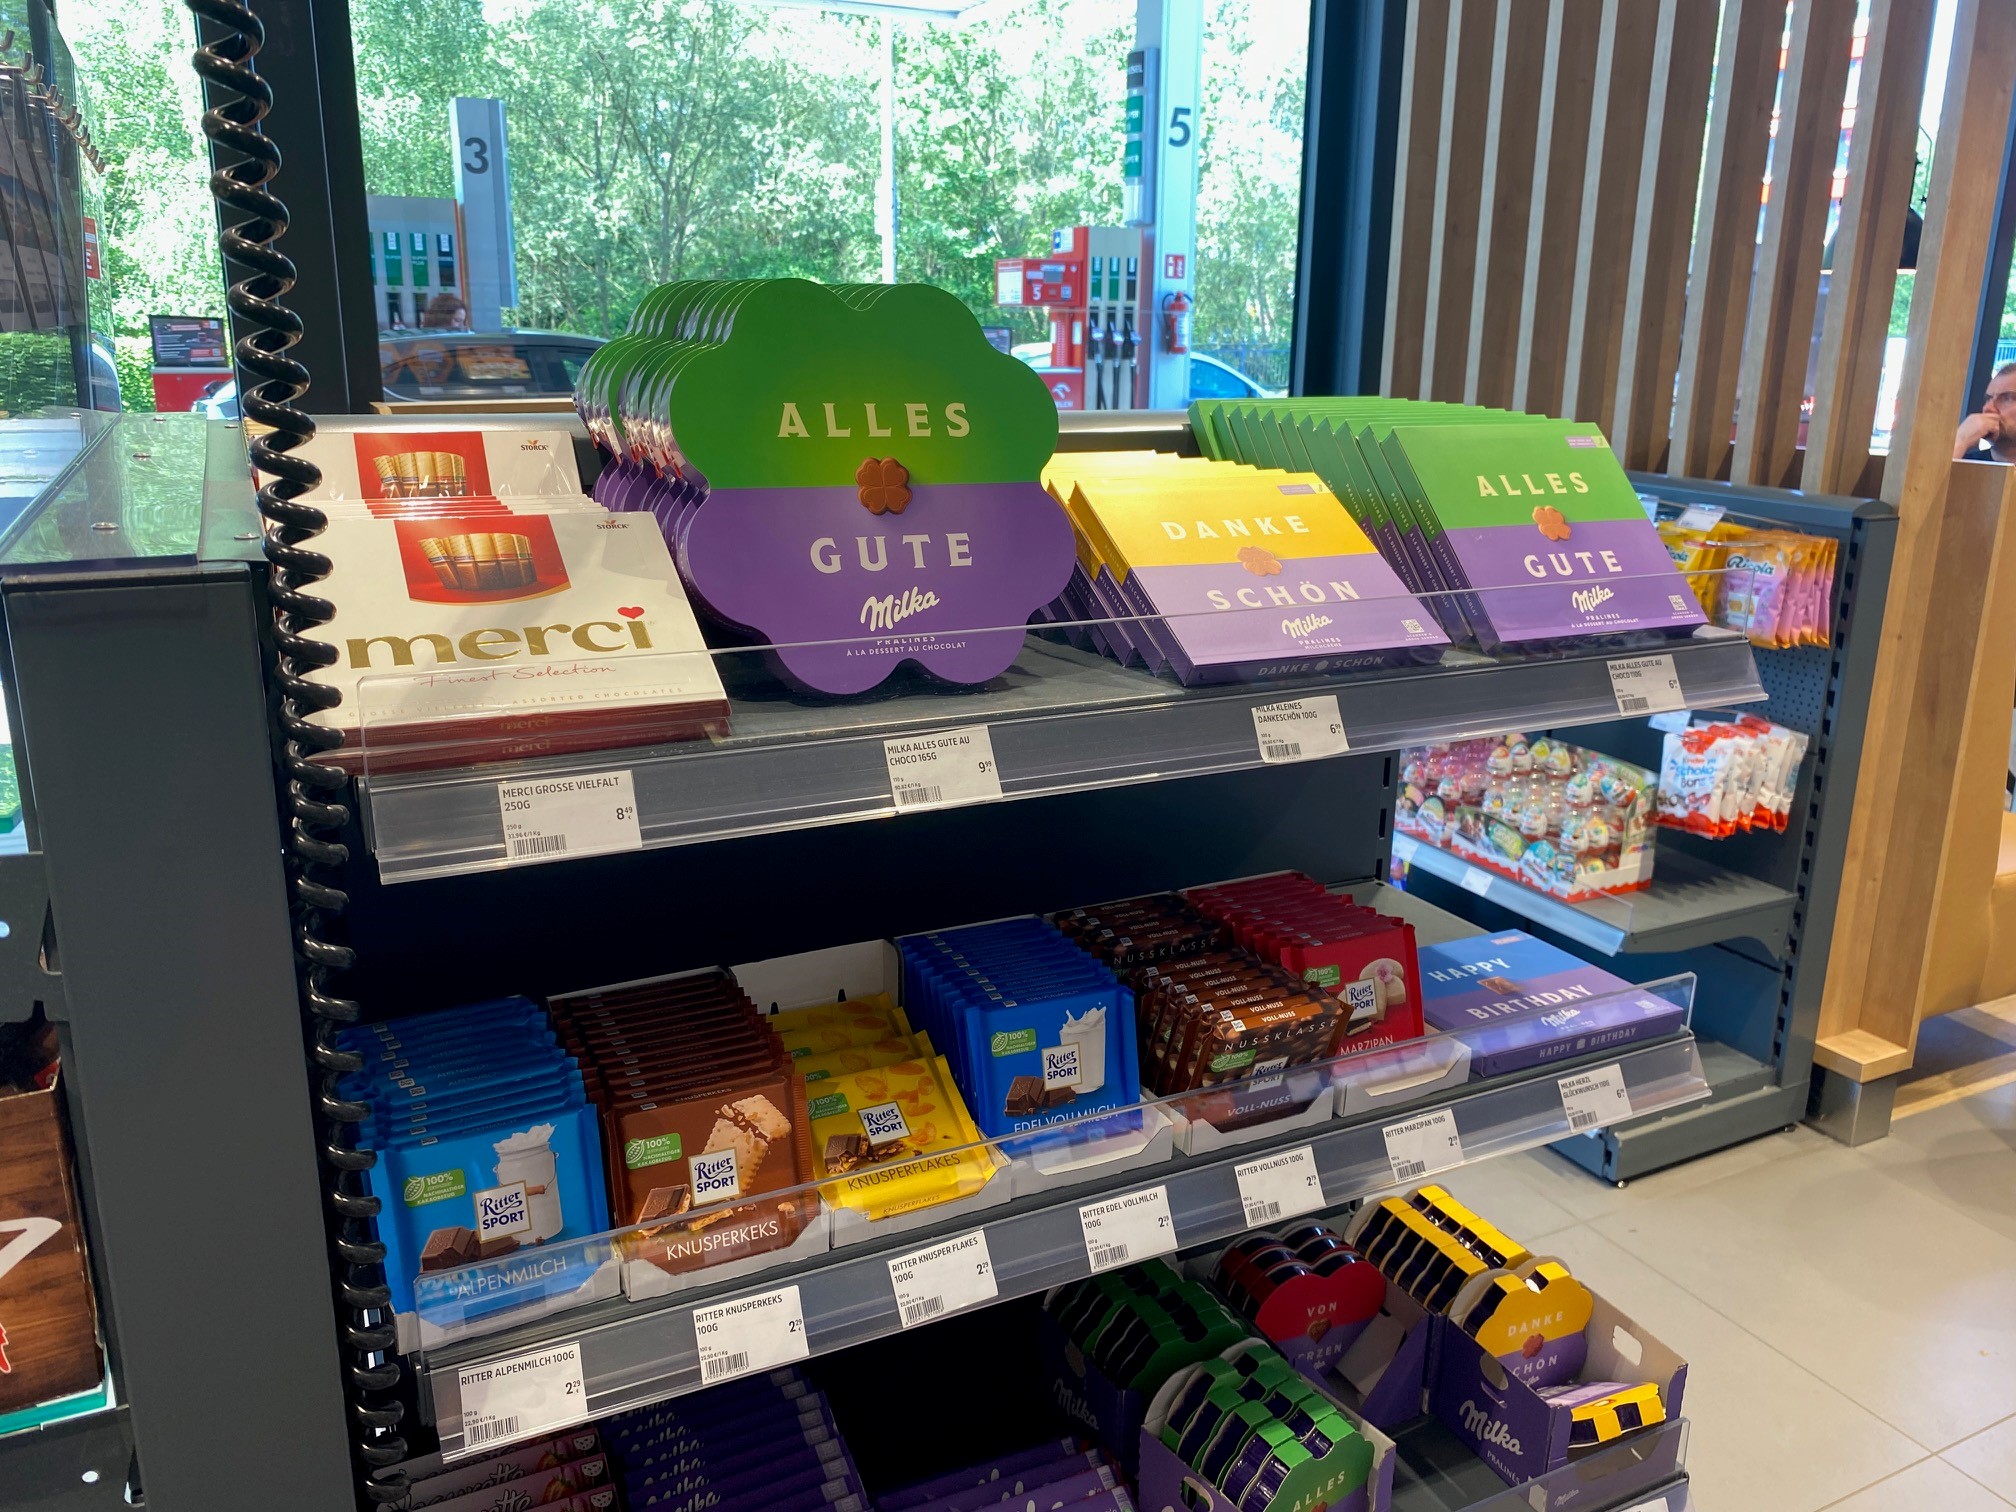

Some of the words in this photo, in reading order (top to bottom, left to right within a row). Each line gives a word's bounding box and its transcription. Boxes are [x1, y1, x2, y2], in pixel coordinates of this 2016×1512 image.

[1168, 107, 1191, 147] 5
[464, 137, 489, 174] 3
[1032, 284, 1042, 300] 5
[777, 402, 970, 438] ALLES
[1477, 472, 1589, 497] ALLES
[1160, 515, 1310, 541] DANKE
[1416, 498, 1435, 535] PRALINES
[809, 532, 973, 574] GUTE
[1523, 550, 1622, 578] GUTE
[1727, 555, 1774, 575] Ricola
[1206, 580, 1361, 611] SCHÖN
[1571, 584, 1615, 614] Milka
[860, 586, 940, 631] Milka
[346, 605, 654, 669] merci
[1281, 613, 1333, 639] Milka
[855, 648, 867, 656] LA
[868, 645, 905, 655] DESSERT
[908, 645, 920, 653] AU
[922, 641, 967, 651] CHOCOLAT
[415, 671, 500, 688] Finest
[512, 664, 617, 681] Selection
[1257, 661, 1310, 677] DANKE
[1333, 655, 1385, 670] SCHÖN
[512, 694, 585, 705] ASSORTED
[595, 687, 683, 699] CHOCOLATES
[1276, 702, 1303, 711] KLEINES
[1258, 711, 1302, 724] DANKESCHÖN
[1301, 711, 1318, 720] 100G
[887, 744, 912, 755] MILKA
[913, 740, 937, 751] ALLES
[937, 737, 958, 748] GUTE
[959, 736, 970, 745] AU
[889, 754, 917, 766] CHOCO
[918, 752, 938, 762] 165G
[502, 786, 534, 799] MERCI
[535, 782, 575, 795] GROSSE
[575, 776, 620, 790] VIELFALT
[504, 800, 531, 811] 250G
[1147, 929, 1179, 938] VOLL-NUSS
[1113, 936, 1217, 965] NUSSKLASSE
[1174, 958, 1207, 970] VOLL-NUSS
[1189, 967, 1222, 979] VOLL-NUSS
[1427, 957, 1511, 982] HAPPY
[1203, 975, 1237, 987] VOLL-NUSS
[1214, 985, 1248, 997] VOLL-NUSS
[1349, 984, 1373, 1001] Ritter
[1230, 993, 1264, 1006] VOLL-NUSS
[1249, 1001, 1284, 1013] VOLL-NUSS
[1351, 998, 1375, 1010] PORT
[1465, 983, 1594, 1020] BIRTHDAY
[1261, 1010, 1296, 1023] VOLL-NUSS
[1540, 1008, 1581, 1028] Milka
[1009, 1030, 1028, 1040] 100%
[1224, 1019, 1337, 1051] NUSSKLASSE
[1340, 1035, 1394, 1056] MARZIPAN
[1539, 1043, 1572, 1058] HAPPY
[1590, 1027, 1637, 1046] BIRTHDAY
[1046, 1050, 1077, 1071] Ritter
[1047, 1066, 1078, 1080] SPORT
[1227, 1094, 1292, 1117] VOLL-NUSS
[864, 1107, 900, 1128] Ritter
[869, 1121, 903, 1136] SPORT
[1385, 1128, 1404, 1139] RITTER
[1404, 1120, 1432, 1134] MARZIPAN
[1431, 1115, 1446, 1125] 100G
[646, 1137, 671, 1149] 100%
[694, 1156, 734, 1182] Ritter
[847, 1152, 961, 1192] KNUSPERFLAKES
[1237, 1165, 1258, 1177] RITTER
[1258, 1157, 1289, 1172] VOLLNUSS
[1289, 1153, 1304, 1164] 100G
[426, 1172, 454, 1186] 100%
[696, 1175, 735, 1194] SPORT
[480, 1190, 523, 1220] Ritter
[883, 1194, 941, 1214] KNUSPERFLAKES
[1082, 1206, 1105, 1219] RITTER
[1106, 1203, 1122, 1213] EDEL
[1122, 1192, 1159, 1208] VOLLMILCH
[482, 1209, 526, 1230] SPORT
[1084, 1218, 1102, 1230] 100G
[665, 1220, 779, 1261] KNUSPERKEKS
[892, 1257, 918, 1273] RITTER
[917, 1246, 952, 1264] KNUSPER
[952, 1236, 978, 1252] FLAKES
[457, 1255, 568, 1299] ALPENMILCH
[894, 1271, 914, 1284] 100G
[695, 1309, 724, 1323] RITTER
[725, 1294, 783, 1316] KNUSPERKEKS
[1306, 1301, 1338, 1318] VON
[697, 1323, 719, 1336] 100G
[1507, 1310, 1564, 1337] DANKE
[461, 1370, 493, 1386] RITTER
[495, 1356, 552, 1378] ALPENMILCH
[552, 1350, 575, 1364] 100G
[1512, 1355, 1559, 1378] CHÖN
[1053, 1377, 1100, 1431] Milka
[1458, 1399, 1524, 1456] Milka
[1292, 1470, 1345, 1512] ALLES
